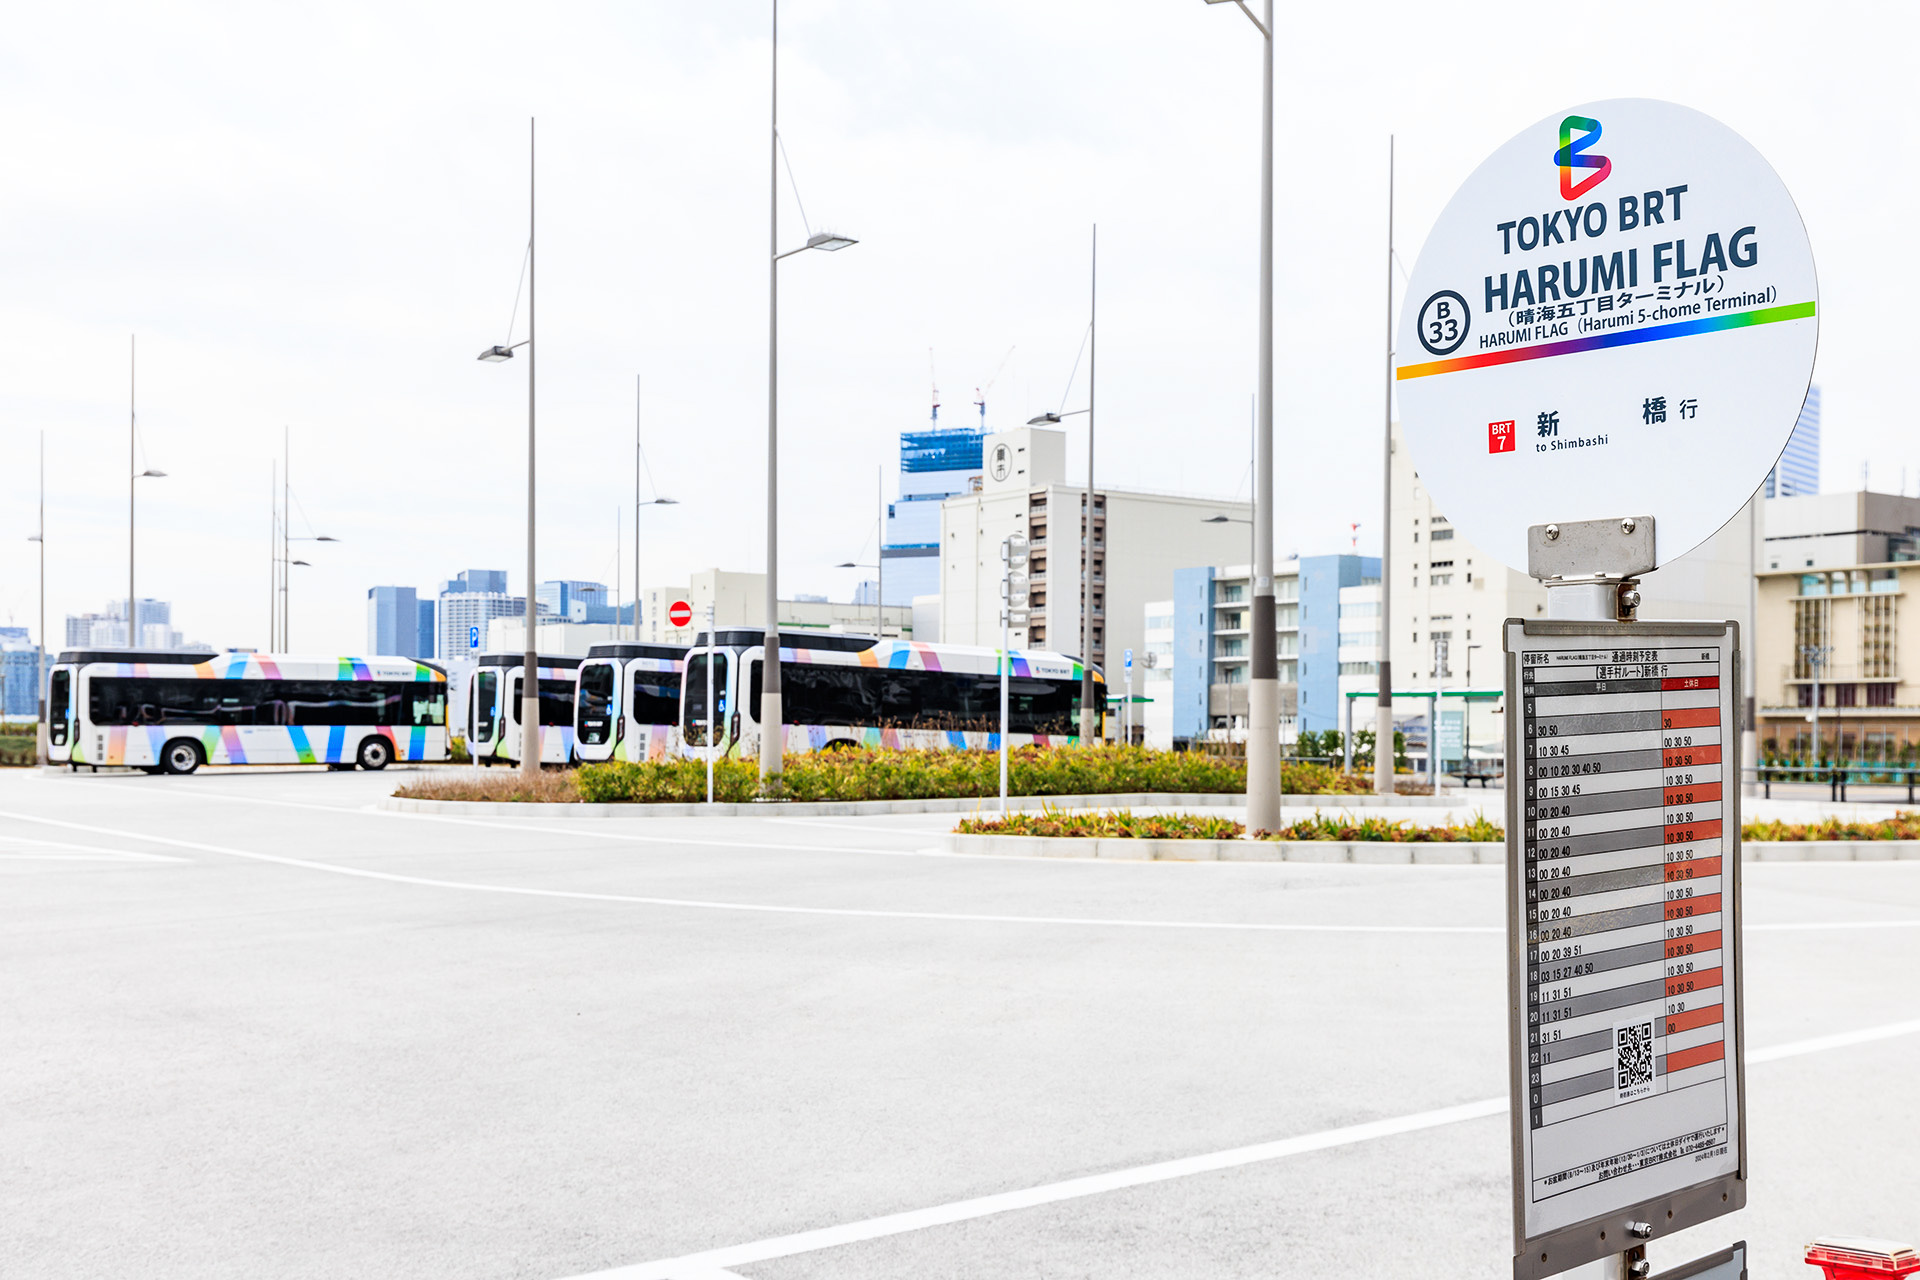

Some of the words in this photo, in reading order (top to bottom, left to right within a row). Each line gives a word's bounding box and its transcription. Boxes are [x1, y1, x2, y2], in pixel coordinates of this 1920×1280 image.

[1497, 202, 1608, 255] TOKYO
[1619, 184, 1688, 232] BRT
[1485, 248, 1638, 313] HARUMI
[1653, 226, 1758, 283] FLAG
[1437, 302, 1451, 319] B
[1480, 328, 1532, 349] HARUMI
[1535, 321, 1569, 340] FLAG
[1637, 300, 1701, 323] 5-chome
[1705, 285, 1777, 312] Terminal)
[1429, 319, 1459, 344] 33
[1536, 410, 1560, 437] 新
[1642, 396, 1667, 425] 橋
[1679, 398, 1698, 420] 行
[1491, 422, 1512, 435] BRT
[1497, 435, 1507, 451] 7
[1535, 442, 1547, 453] to
[1550, 434, 1609, 451] Shimbashi
[1523, 653, 1550, 665] 停留所名
[1611, 650, 1658, 663] 通過時刻予定表
[1661, 664, 1668, 677] 行
[1596, 682, 1607, 692] 平日
[1684, 679, 1699, 688] 土休日
[1528, 704, 1533, 714] 5
[1528, 724, 1533, 734] 6
[1538, 726, 1547, 736] 30
[1549, 725, 1558, 735] 50
[1664, 719, 1671, 728] 30
[1529, 744, 1533, 755] 7
[1539, 747, 1547, 757] 10
[1550, 746, 1558, 755] 30
[1561, 745, 1569, 754] 45
[1664, 738, 1672, 747] 00
[1674, 737, 1681, 746] 30
[1684, 736, 1691, 746] 50
[1529, 765, 1534, 775] 8
[1539, 767, 1547, 777] 00
[1551, 766, 1558, 776] 10
[1561, 765, 1570, 775] 20
[1572, 765, 1580, 774] 30
[1583, 764, 1591, 773] 40
[1593, 762, 1601, 772] 50
[1665, 757, 1672, 766] 10
[1675, 756, 1682, 765] 30
[1684, 755, 1692, 764] 50
[1529, 786, 1534, 796] 9
[1539, 787, 1547, 797] 00
[1551, 786, 1558, 796] 15
[1562, 786, 1570, 795] 30
[1572, 785, 1580, 794] 45
[1666, 775, 1672, 785] 10
[1675, 775, 1682, 784] 30
[1684, 774, 1692, 783] 50
[1528, 807, 1535, 817] 10
[1539, 808, 1547, 818] 00
[1551, 807, 1559, 817] 20
[1562, 805, 1570, 816] 40
[1667, 794, 1673, 804] 10
[1676, 793, 1683, 803] 30
[1685, 792, 1693, 801] 50
[1528, 828, 1535, 838] 11
[1539, 828, 1547, 838] 00
[1551, 827, 1559, 837] 20
[1562, 826, 1570, 836] 40
[1667, 814, 1673, 823] 10
[1676, 813, 1683, 822] 30
[1685, 812, 1693, 821] 50
[1528, 848, 1535, 858] 12
[1539, 849, 1547, 859] 00
[1551, 848, 1559, 857] 20
[1562, 846, 1570, 856] 40
[1667, 833, 1673, 843] 10
[1676, 832, 1683, 842] 30
[1685, 831, 1693, 840] 50
[1528, 869, 1535, 879] 13
[1539, 869, 1548, 879] 00
[1551, 868, 1559, 878] 20
[1562, 866, 1570, 876] 40
[1667, 852, 1673, 862] 10
[1676, 851, 1683, 861] 30
[1685, 850, 1693, 859] 50
[1529, 889, 1536, 899] 14
[1540, 889, 1548, 900] 00
[1551, 888, 1560, 898] 20
[1562, 887, 1571, 897] 40
[1529, 909, 1536, 919] 15
[1540, 910, 1548, 920] 00
[1552, 908, 1560, 918] 20
[1563, 907, 1571, 917] 40
[1667, 890, 1673, 900] 10
[1676, 889, 1683, 899] 30
[1685, 888, 1693, 897] 50
[1530, 950, 1537, 960] 17
[1541, 951, 1549, 961] 00
[1552, 949, 1560, 959] 20
[1563, 948, 1571, 958] 39
[1574, 946, 1581, 956] 51
[1667, 928, 1673, 937] 10
[1676, 927, 1683, 936] 30
[1685, 926, 1693, 935] 50
[1530, 971, 1537, 981] 18
[1541, 971, 1549, 981] 03
[1553, 970, 1560, 979] 15
[1563, 968, 1571, 978] 27
[1574, 966, 1583, 976] 40
[1585, 963, 1593, 973] 50
[1667, 947, 1674, 956] 10
[1676, 946, 1683, 955] 30
[1685, 944, 1693, 954] 50
[1530, 991, 1537, 1001] 19
[1542, 991, 1548, 1001] 11
[1553, 989, 1560, 999] 31
[1563, 988, 1571, 998] 51
[1667, 965, 1674, 975] 10
[1676, 964, 1683, 974] 30
[1686, 963, 1694, 973] 50
[1530, 1012, 1538, 1022] 20
[1542, 1012, 1549, 1023] 11
[1553, 1011, 1560, 1020] 31
[1564, 1007, 1572, 1018] 51
[1668, 984, 1674, 994] 10
[1677, 983, 1684, 992] 30
[1686, 981, 1694, 991] 50
[1531, 1033, 1537, 1043] 21
[1542, 1032, 1550, 1042] 31
[1553, 1030, 1561, 1040] 51
[1668, 1004, 1674, 1014] 10
[1677, 1002, 1684, 1012] 30
[1531, 1053, 1539, 1063] 22
[1543, 1053, 1549, 1063] 11
[1668, 1023, 1675, 1033] 00
[1532, 1073, 1539, 1083] 23
[1534, 1095, 1538, 1104] 0
[1535, 1114, 1537, 1124] 1
